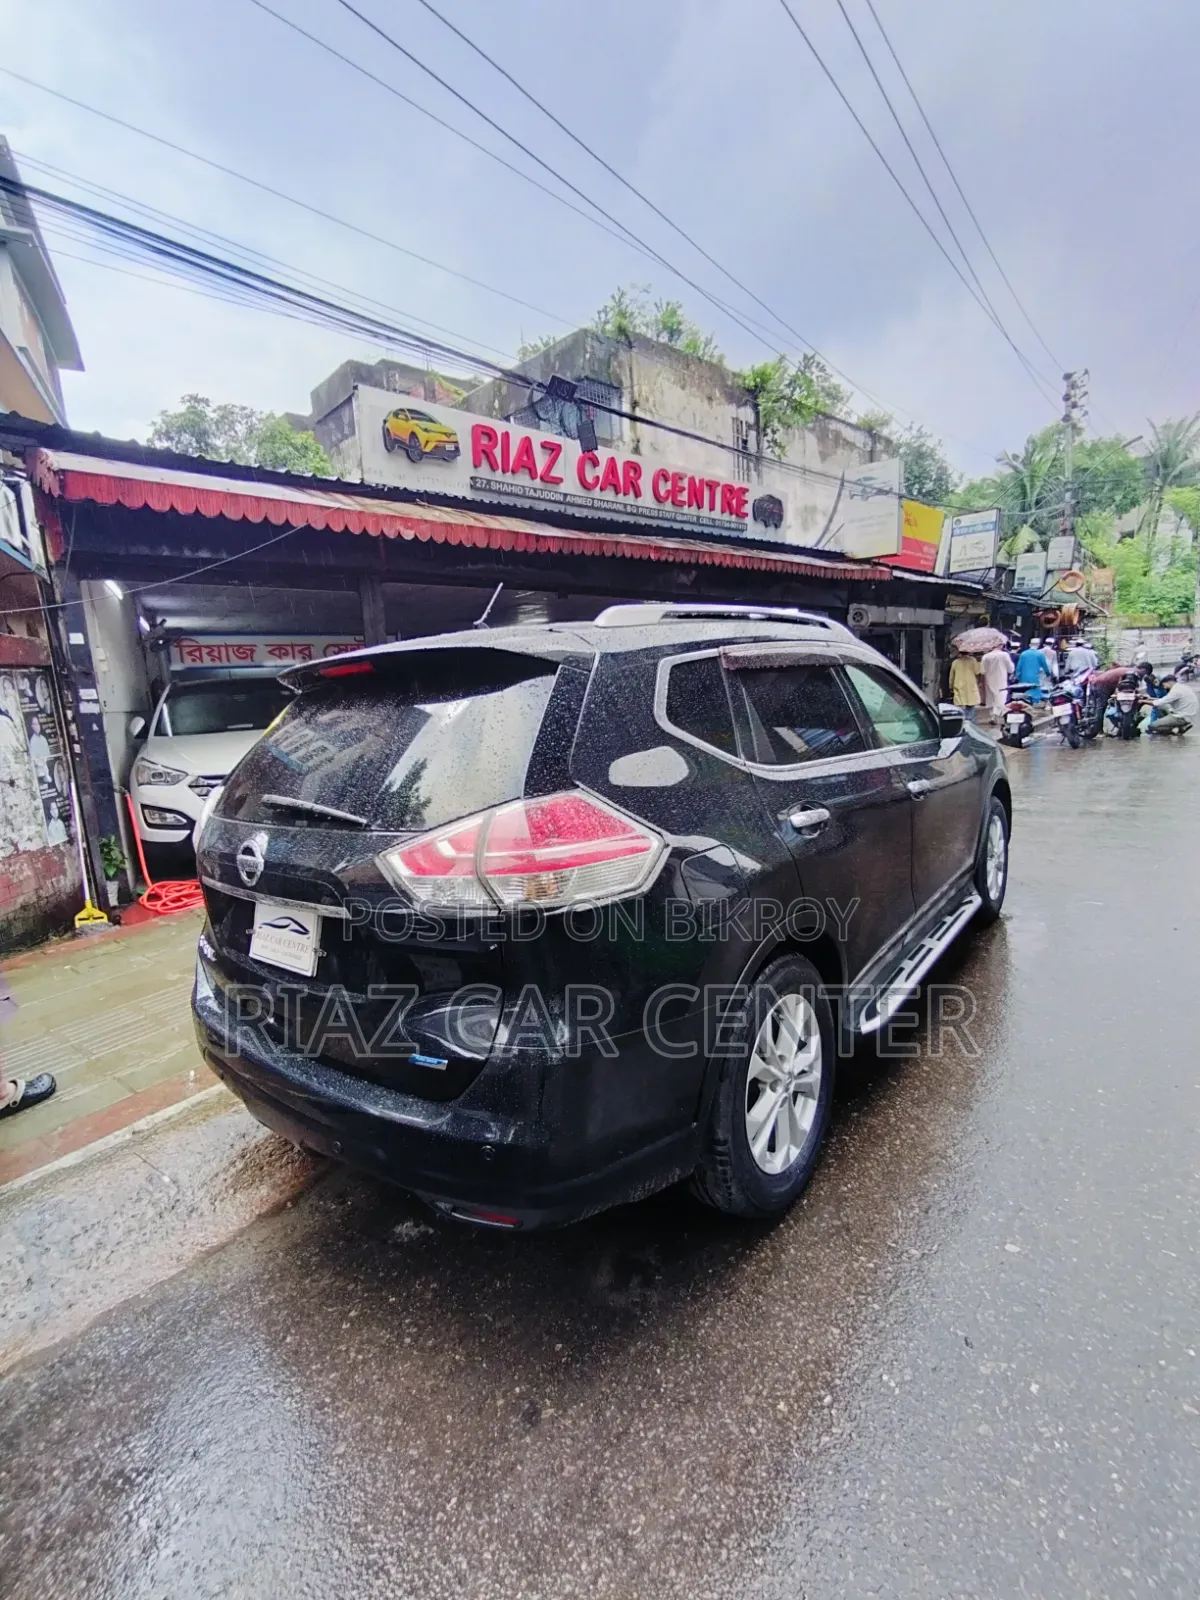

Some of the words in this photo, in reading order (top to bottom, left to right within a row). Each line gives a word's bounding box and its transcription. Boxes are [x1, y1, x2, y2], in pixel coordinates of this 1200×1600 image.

[471, 423, 564, 485] RIAZ
[577, 451, 642, 499] CAR
[652, 468, 750, 518] CENTRE
[490, 482, 523, 495] SHAHID
[525, 487, 564, 502] TAJUDDIN
[566, 495, 593, 507] AHMED
[638, 507, 659, 517] PRESS
[658, 510, 675, 520] STAFF
[174, 637, 257, 664] রিয়াজ
[264, 642, 314, 661] কার
